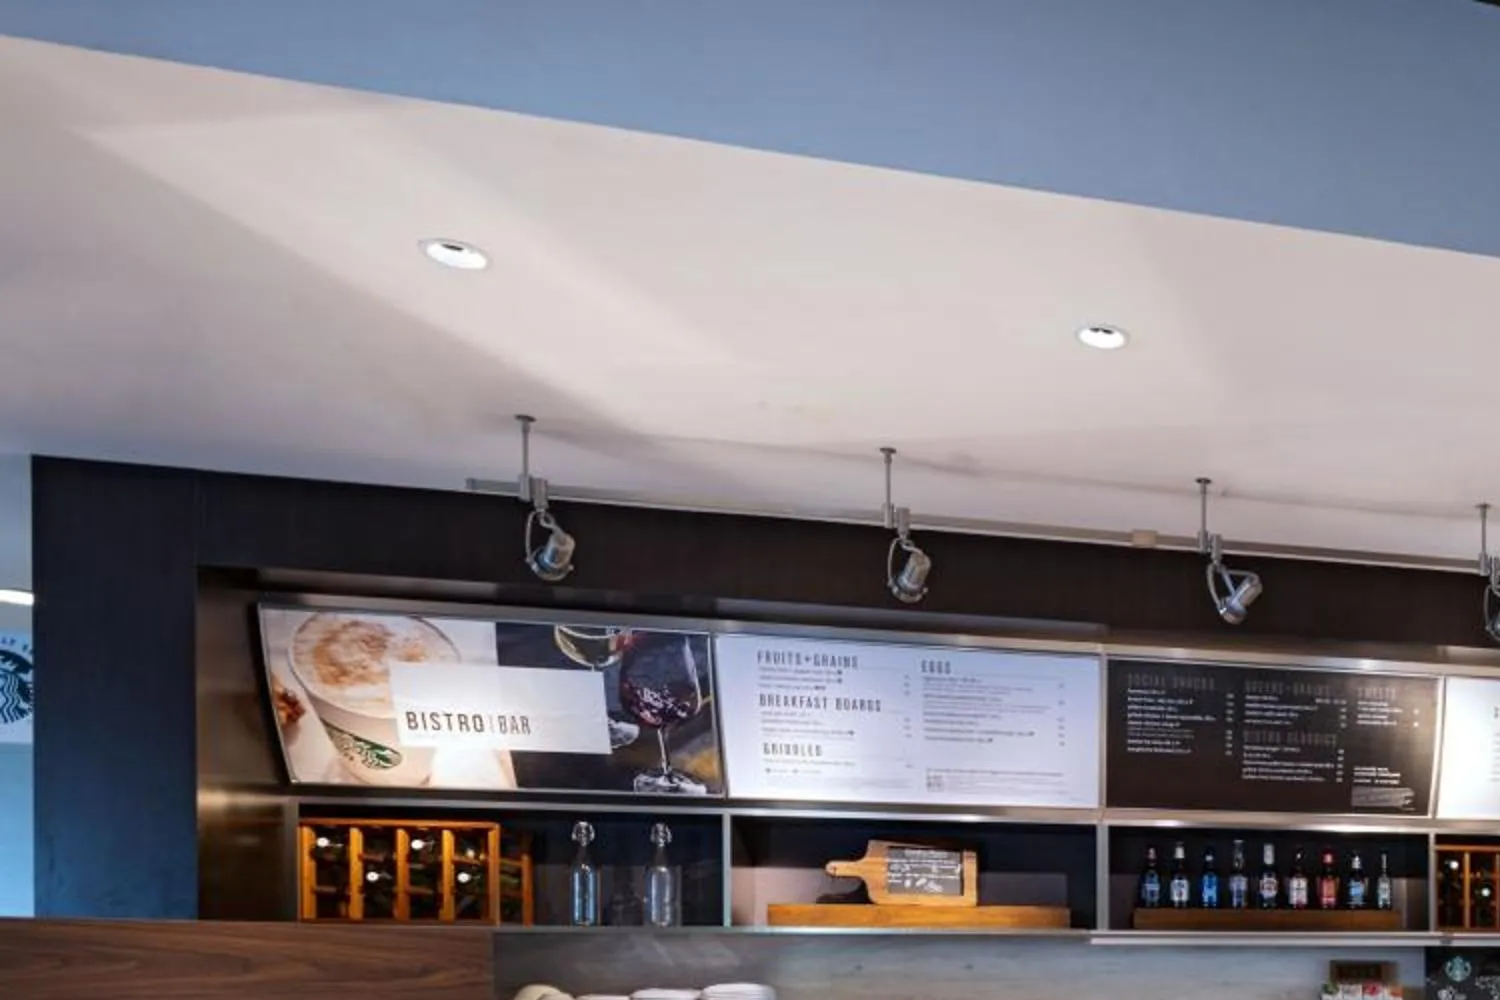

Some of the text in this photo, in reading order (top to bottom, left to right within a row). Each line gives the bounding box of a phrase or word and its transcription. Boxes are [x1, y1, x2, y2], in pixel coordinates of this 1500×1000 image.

[759, 693, 881, 712] BREAKFAST BOARDS
[405, 711, 532, 735] BISTRO BAR
